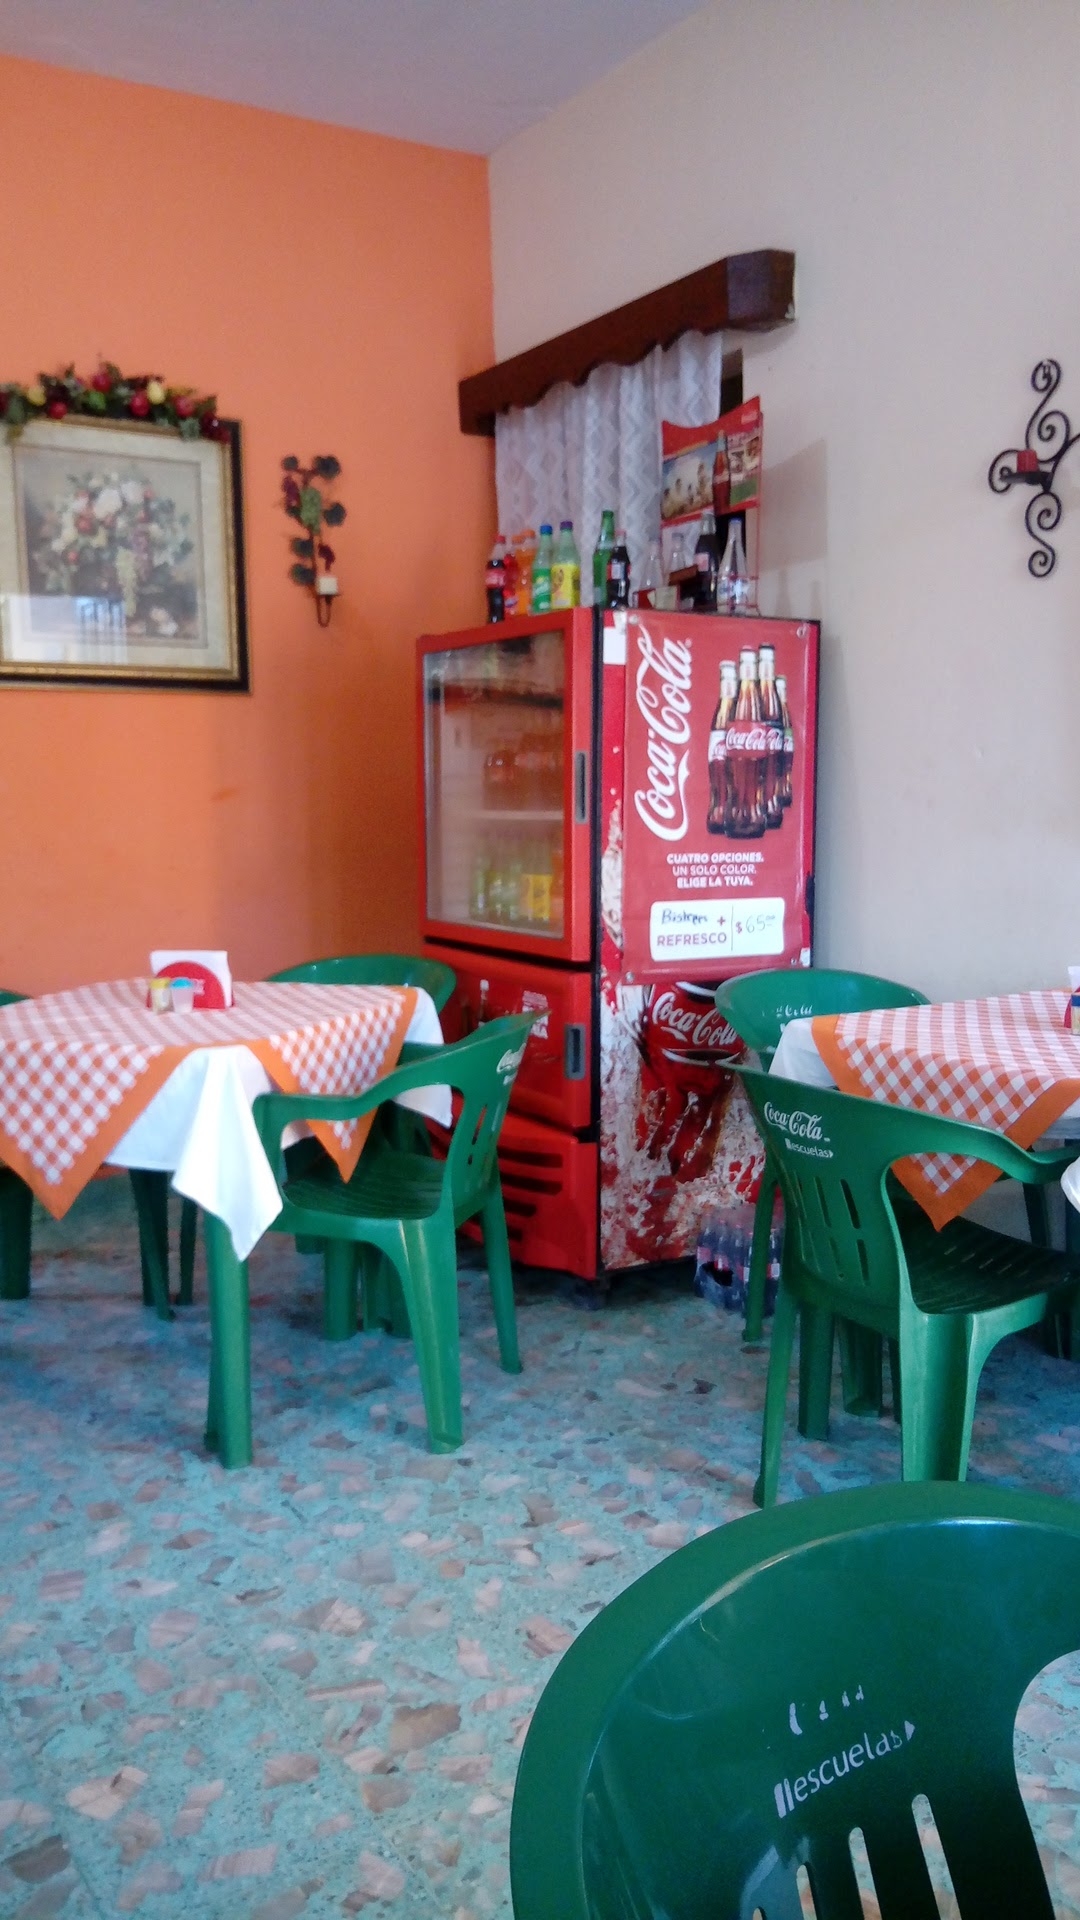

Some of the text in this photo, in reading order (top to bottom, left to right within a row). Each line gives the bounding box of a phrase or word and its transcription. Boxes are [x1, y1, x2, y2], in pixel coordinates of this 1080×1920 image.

[666, 852, 764, 865] CUATRO OPCIONES.
[672, 864, 757, 876] UN SOLO COLOR.
[677, 876, 754, 889] ELIGE LA TUYA.
[656, 932, 727, 947] REFRESCO
